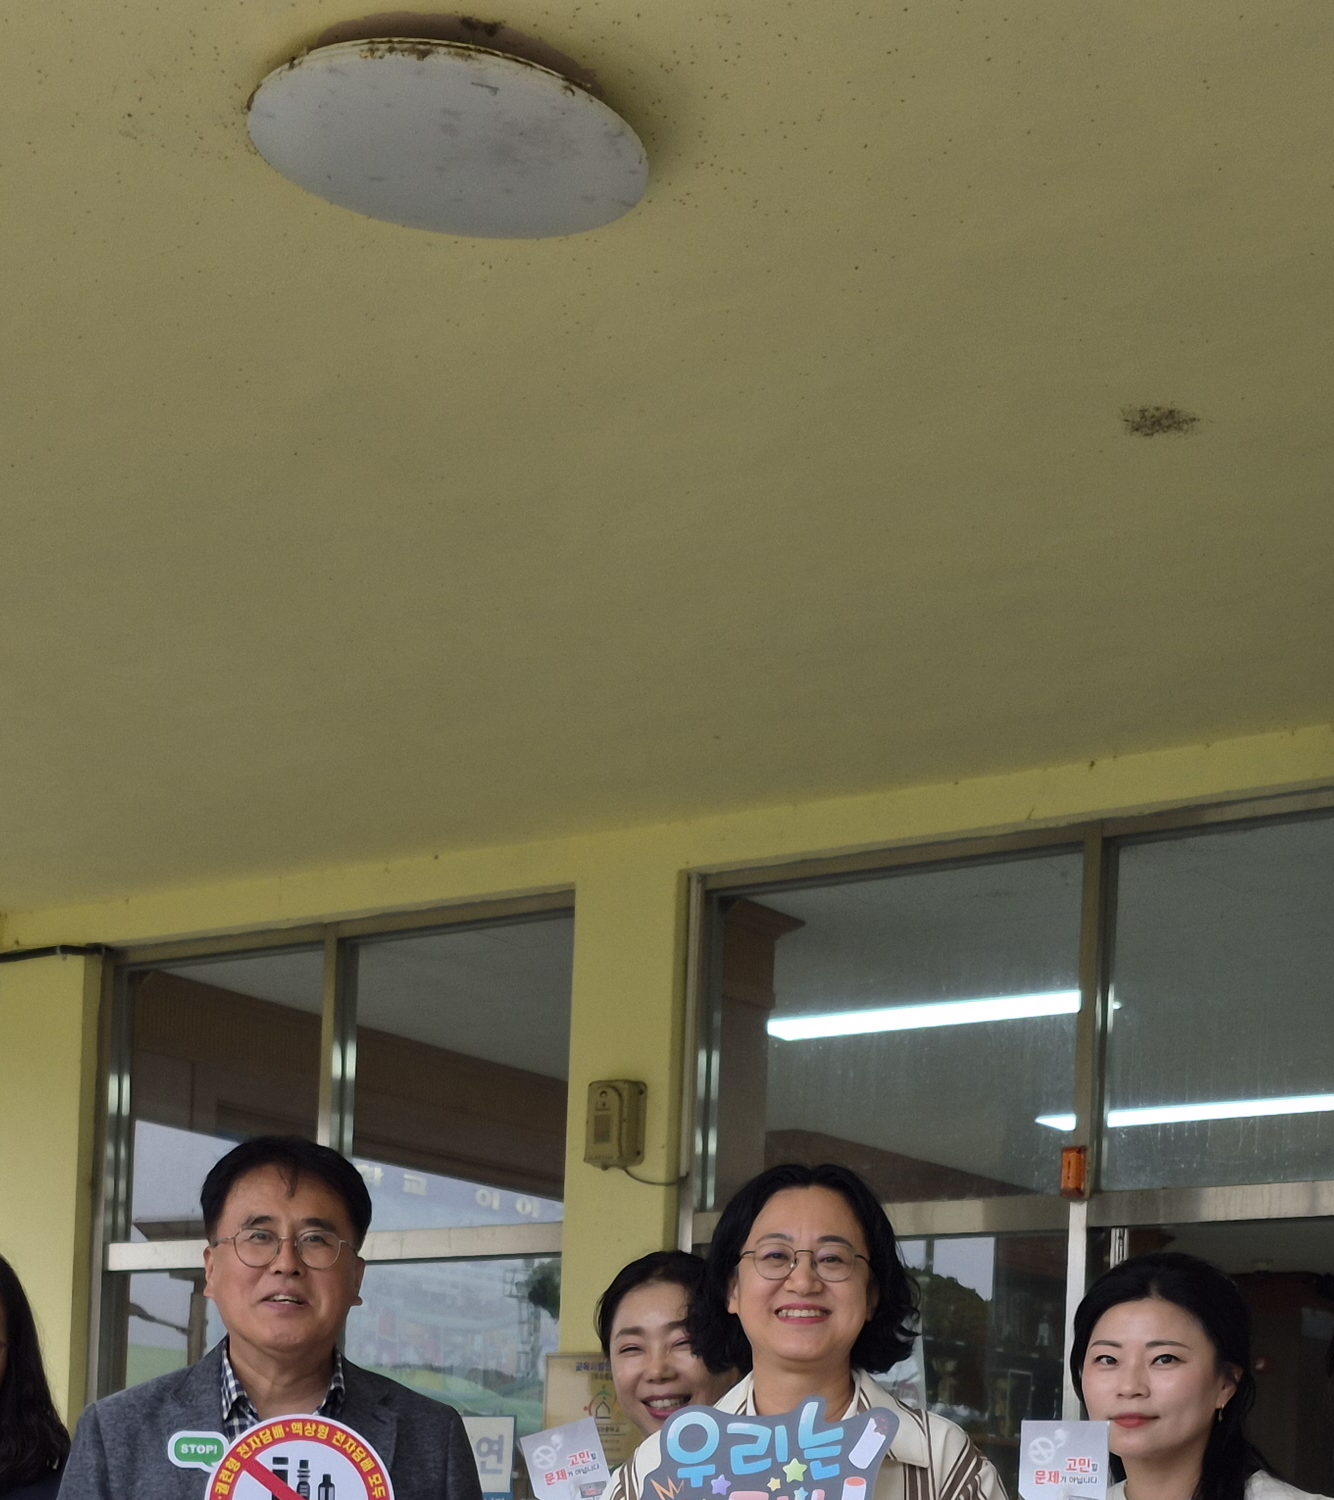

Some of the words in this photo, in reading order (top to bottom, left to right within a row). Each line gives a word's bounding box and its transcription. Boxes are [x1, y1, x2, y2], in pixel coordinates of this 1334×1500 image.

[180, 1443, 218, 1455] STOP!
[666, 1401, 843, 1488] 우리는
[368, 1473, 386, 1498] 모두
